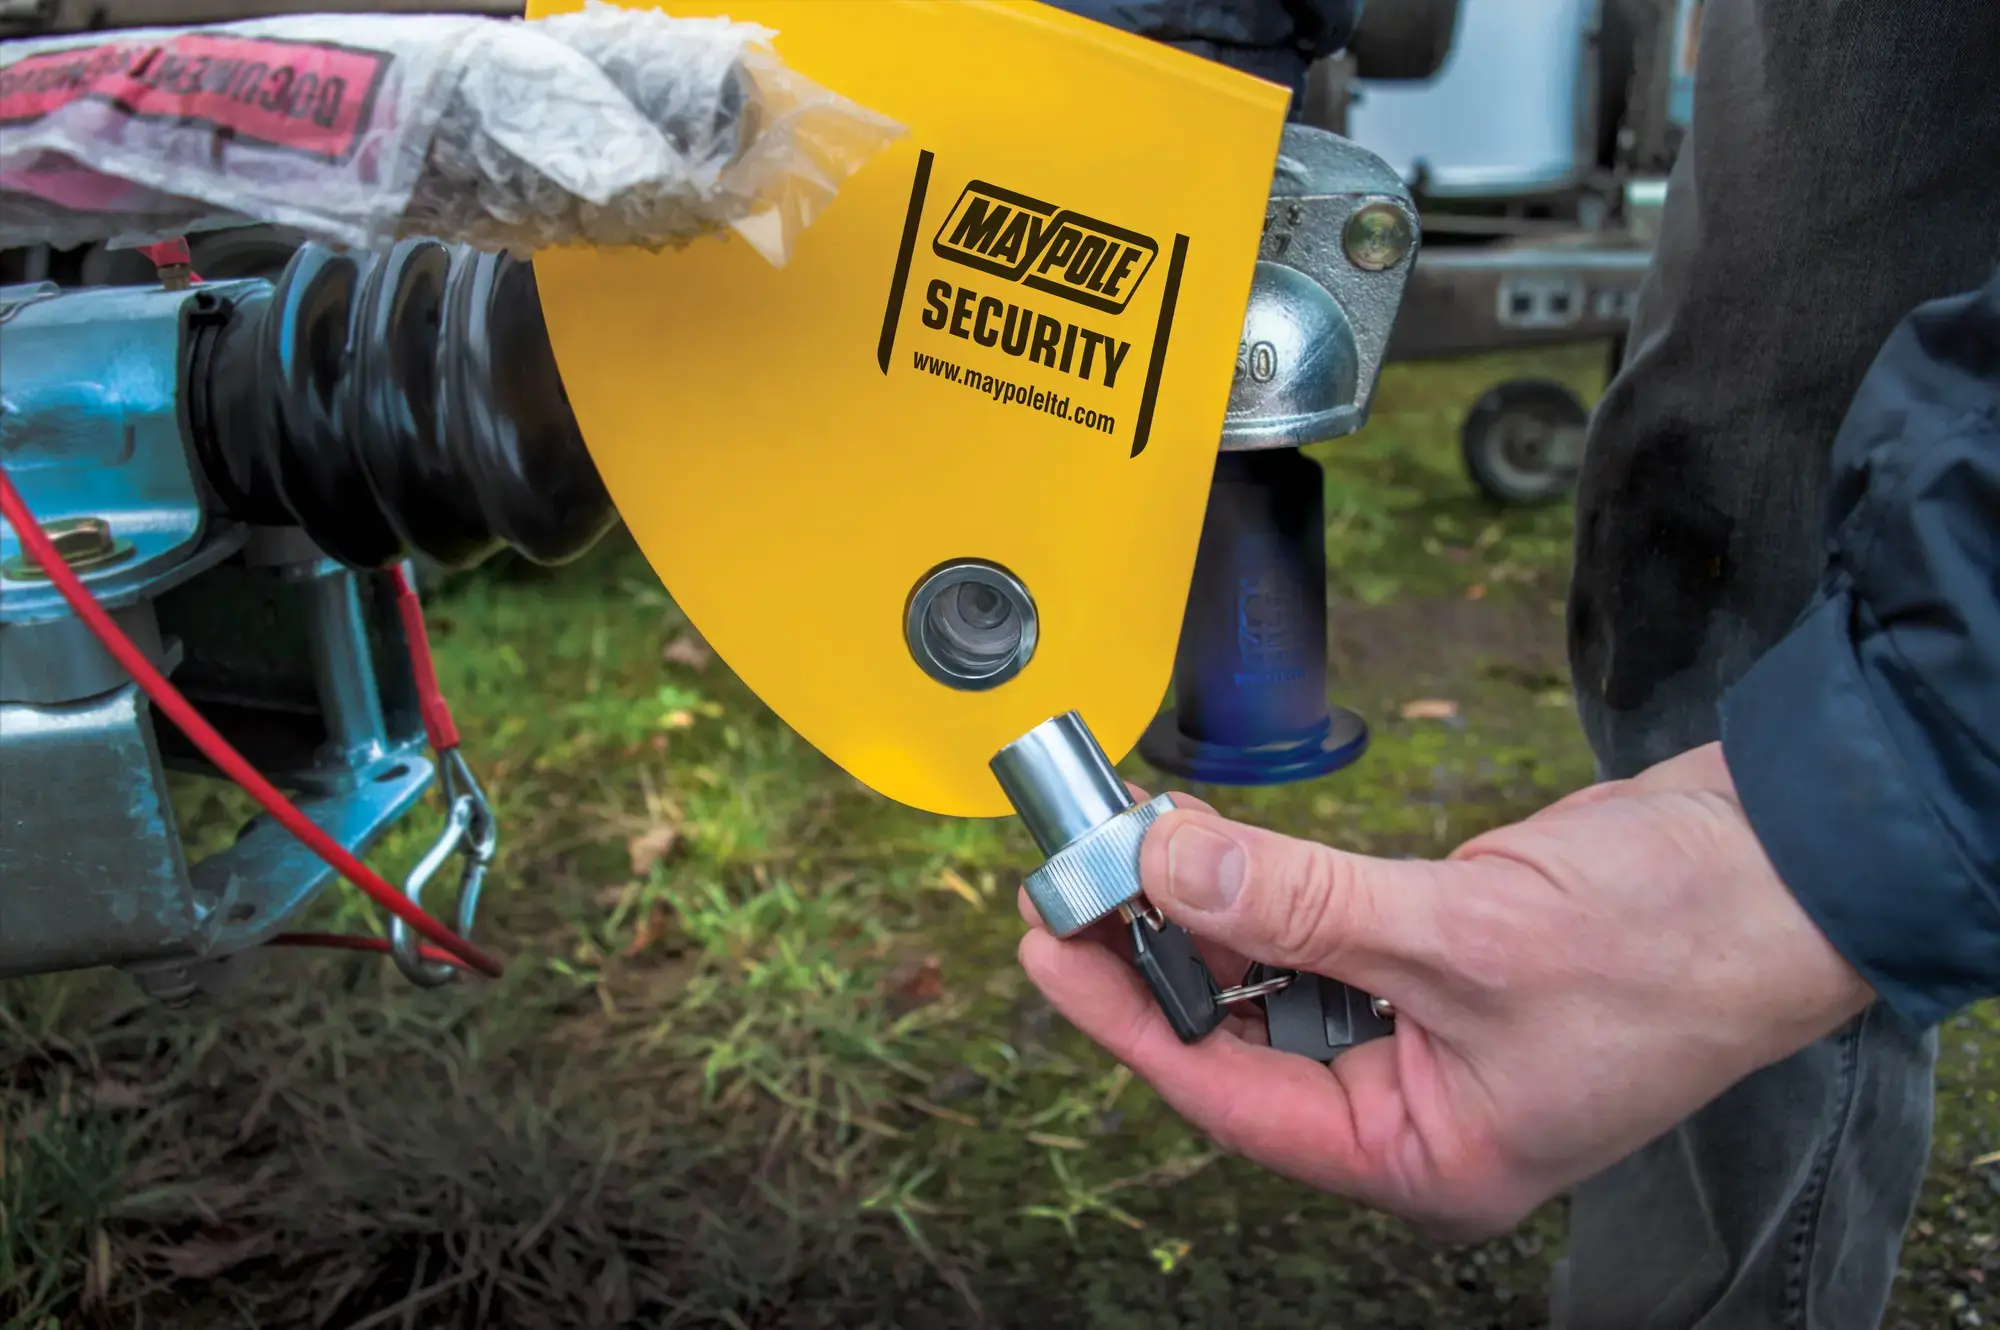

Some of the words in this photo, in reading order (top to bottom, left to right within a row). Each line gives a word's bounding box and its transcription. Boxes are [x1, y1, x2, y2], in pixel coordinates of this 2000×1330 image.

[948, 197, 1143, 298] MAYPOLE
[922, 279, 1131, 389] SECURITY
[913, 351, 1116, 435] www.maypoleltd.com
